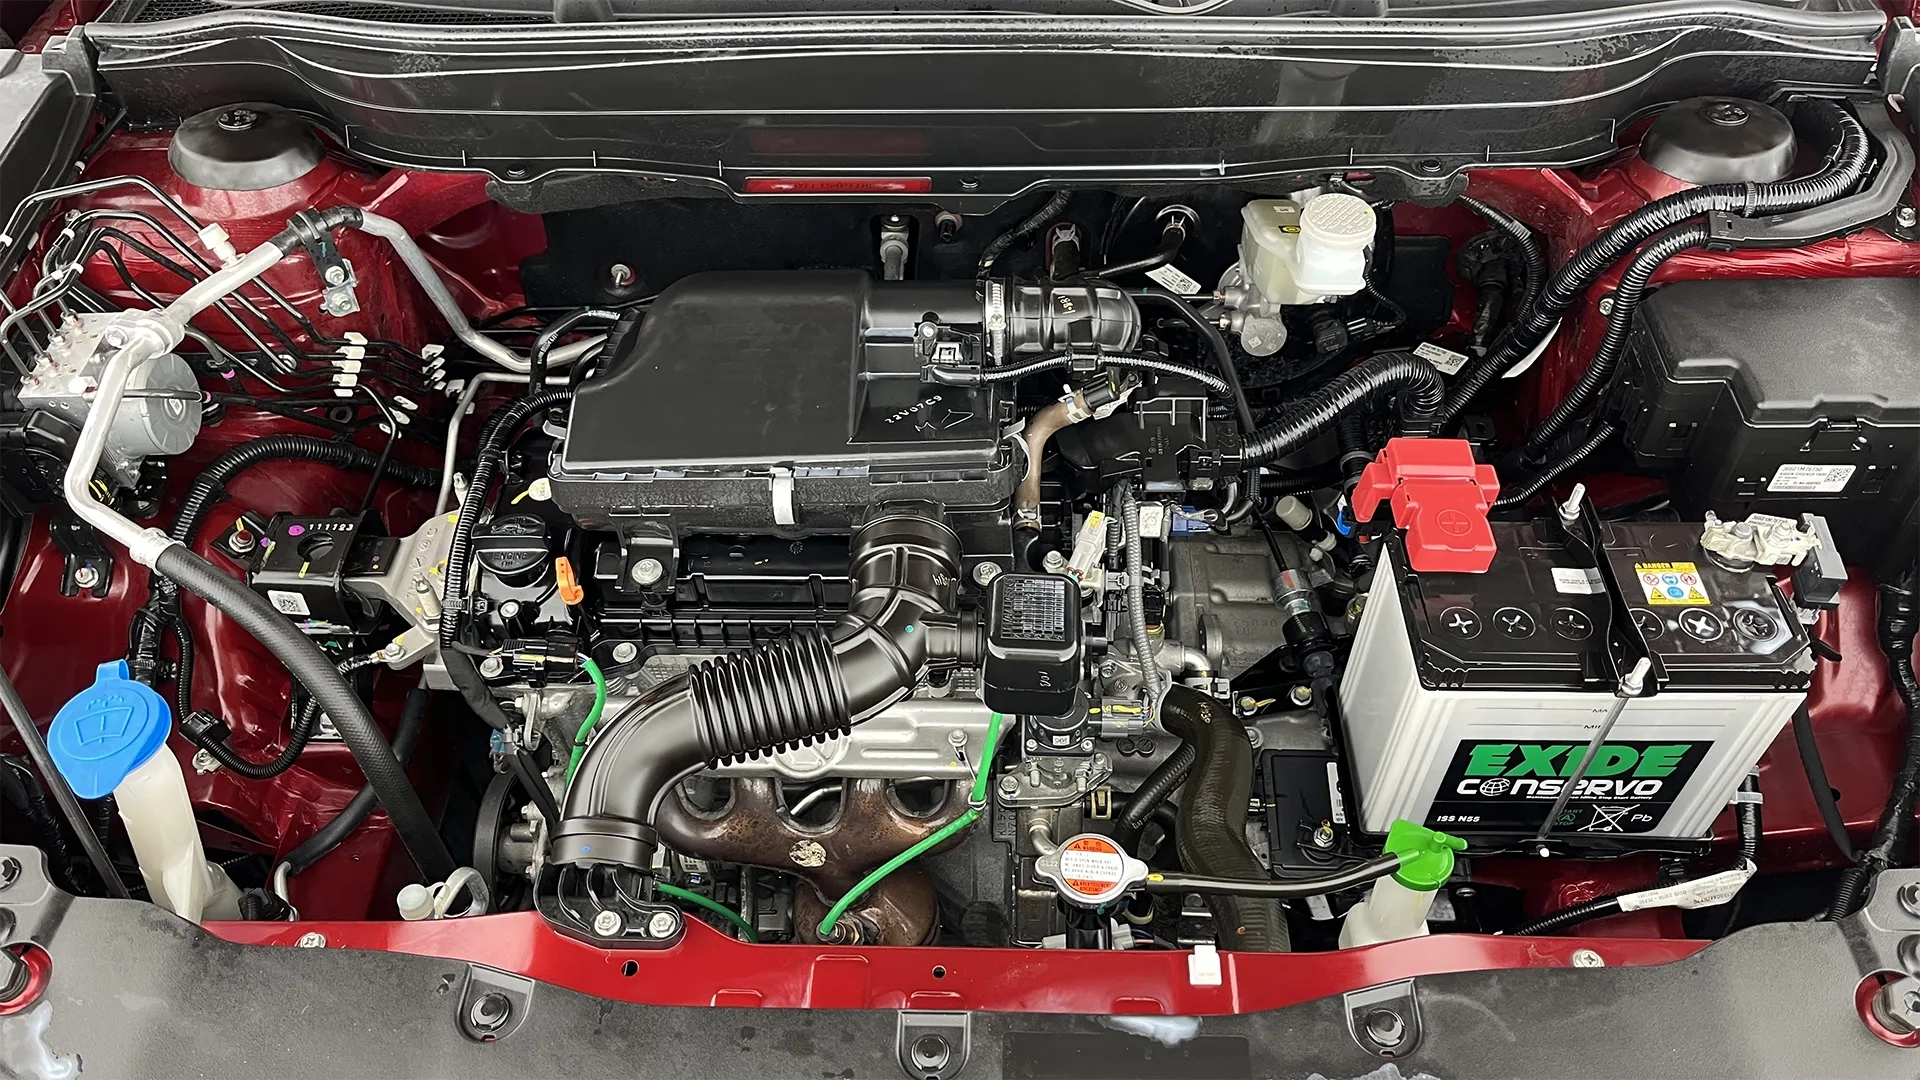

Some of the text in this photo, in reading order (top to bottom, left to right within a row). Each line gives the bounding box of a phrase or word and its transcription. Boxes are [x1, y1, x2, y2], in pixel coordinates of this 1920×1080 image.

[309, 523, 354, 531] 111123
[492, 551, 528, 560] ENGINE
[1464, 743, 1692, 777] EXIDE
[1631, 814, 1653, 822] Pb
